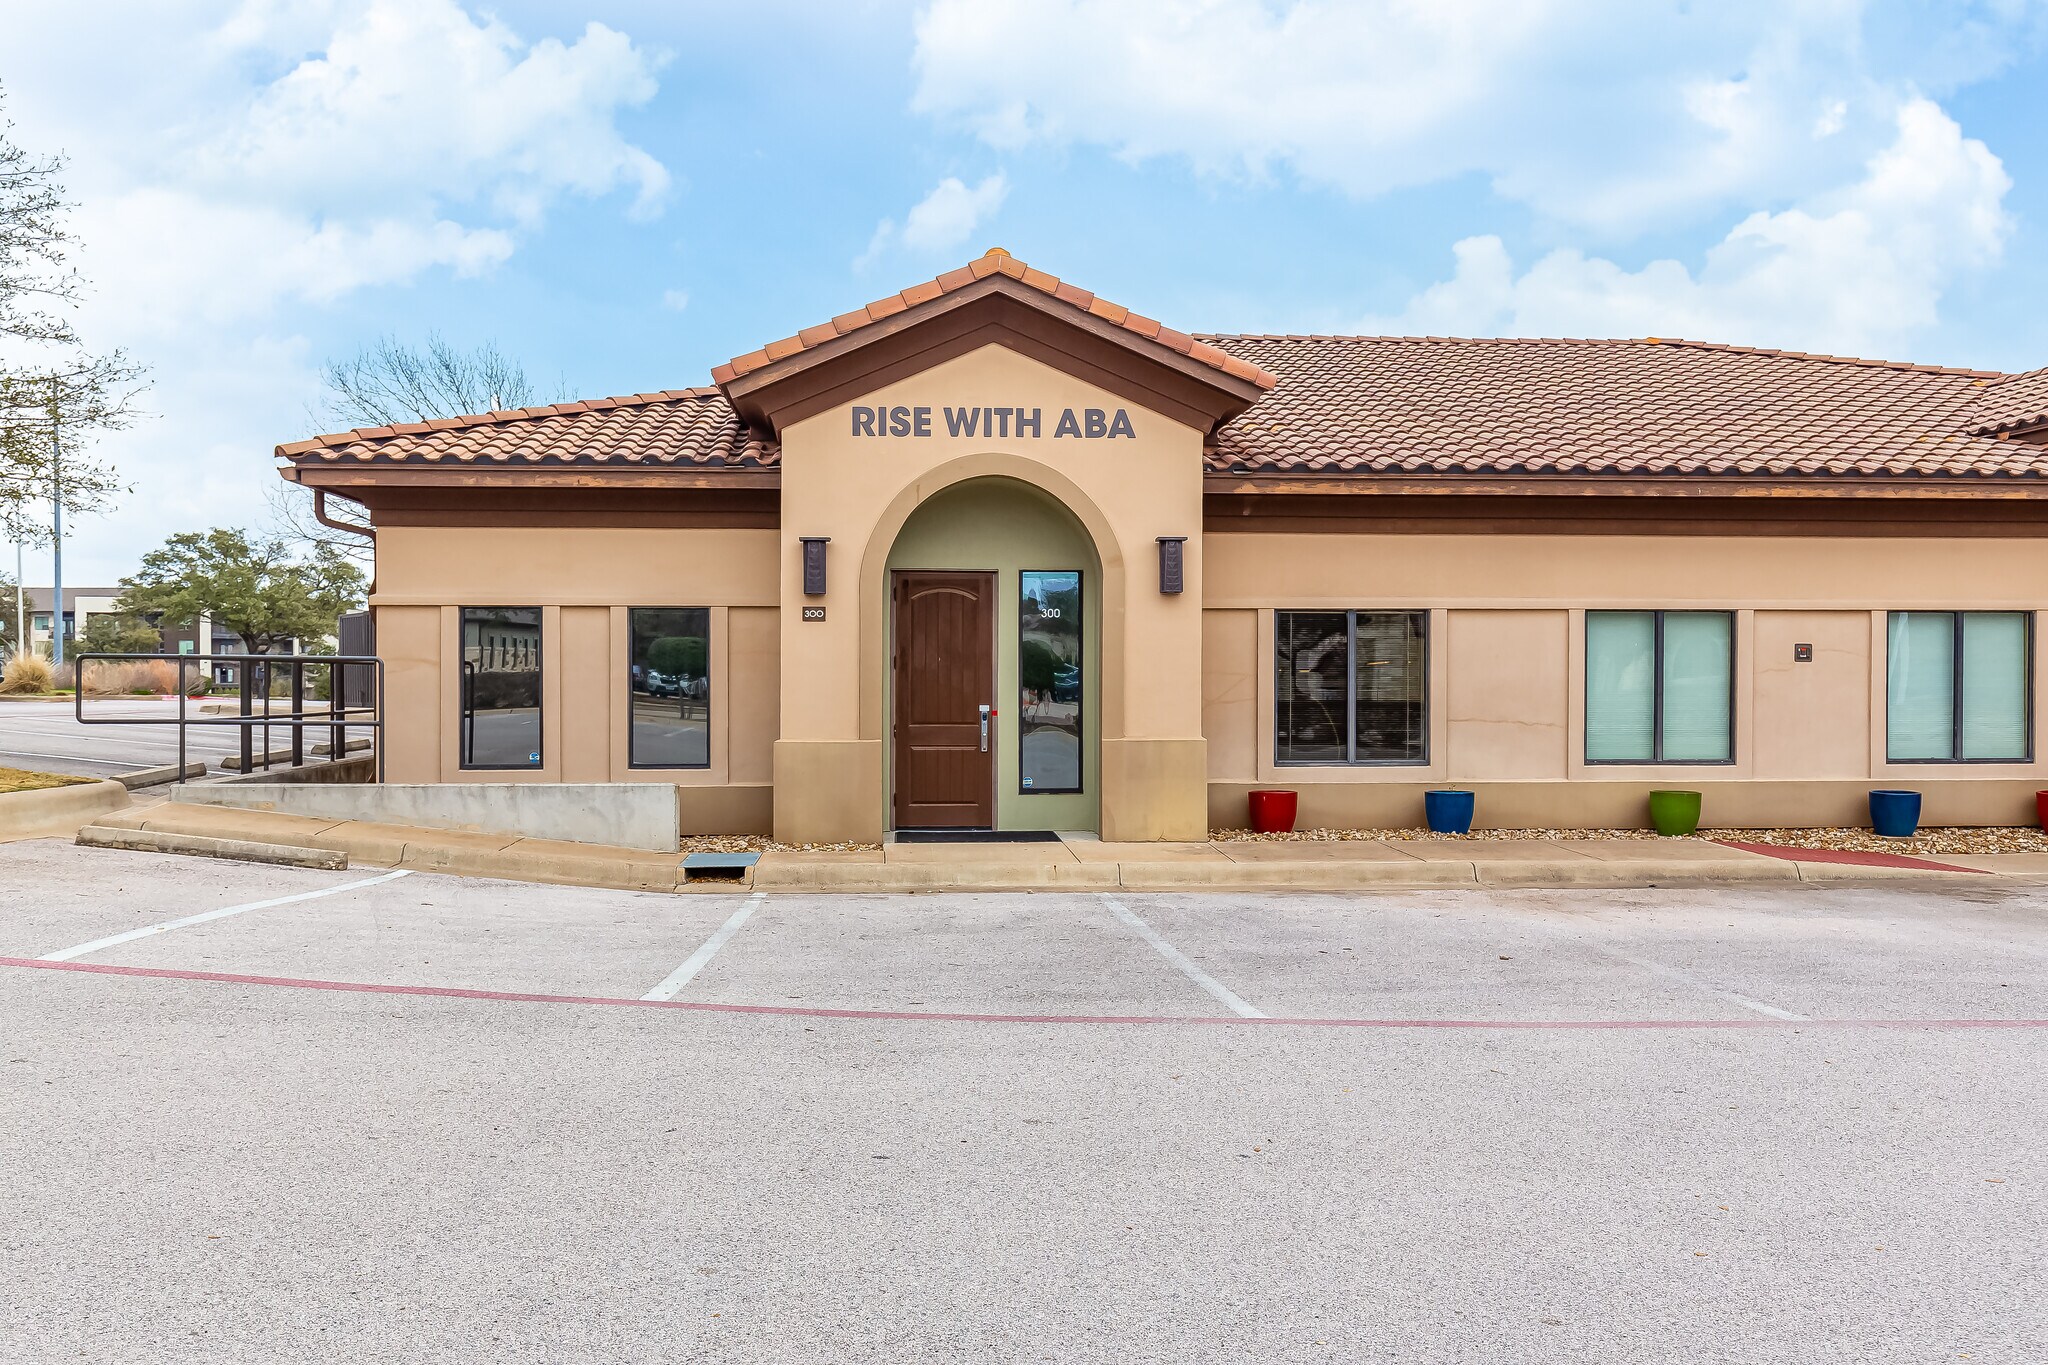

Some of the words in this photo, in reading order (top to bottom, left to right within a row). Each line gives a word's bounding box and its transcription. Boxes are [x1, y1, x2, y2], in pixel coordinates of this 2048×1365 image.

[852, 406, 932, 437] RISE
[943, 407, 1041, 438] WITH
[1053, 408, 1136, 439] ABA
[1041, 608, 1060, 618] 300
